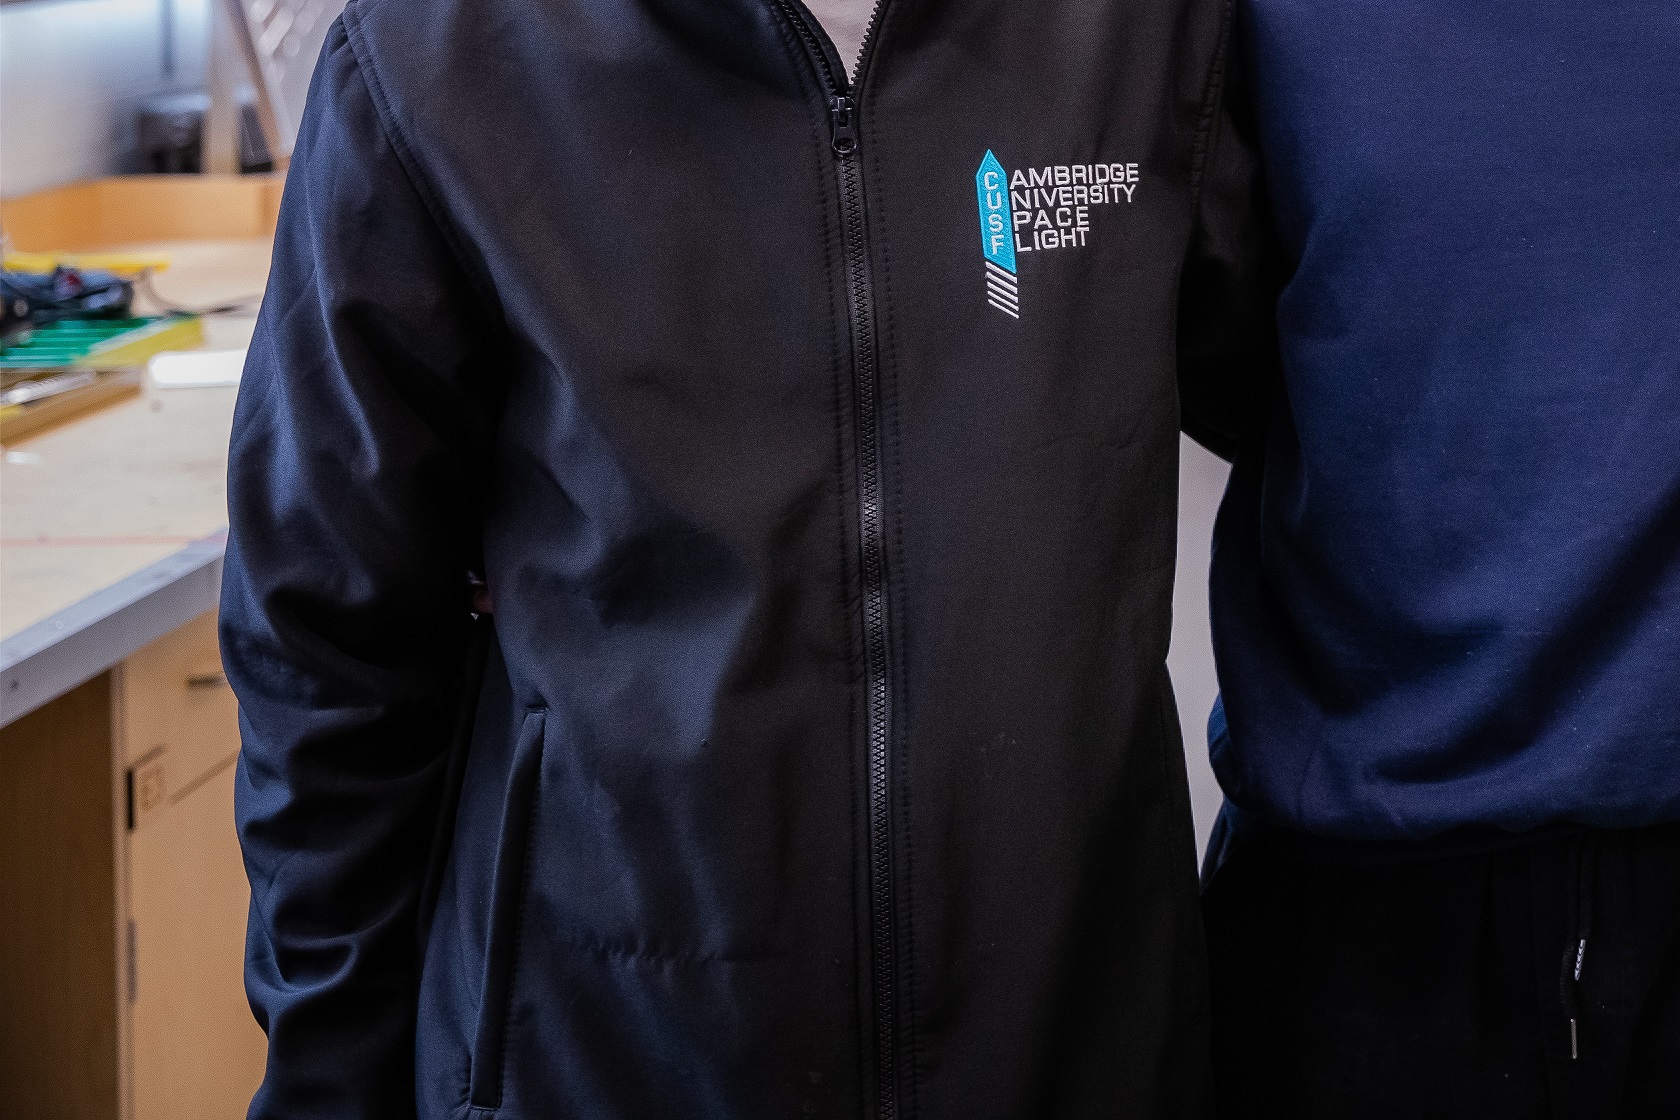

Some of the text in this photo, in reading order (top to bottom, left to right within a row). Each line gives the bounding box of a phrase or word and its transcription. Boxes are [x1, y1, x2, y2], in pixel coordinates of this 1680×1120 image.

[1010, 163, 1139, 189] AMBRIDGE
[1011, 184, 1136, 210] NIVERSITY
[1012, 206, 1089, 231] PACE
[1015, 227, 1089, 253] LIGHT
